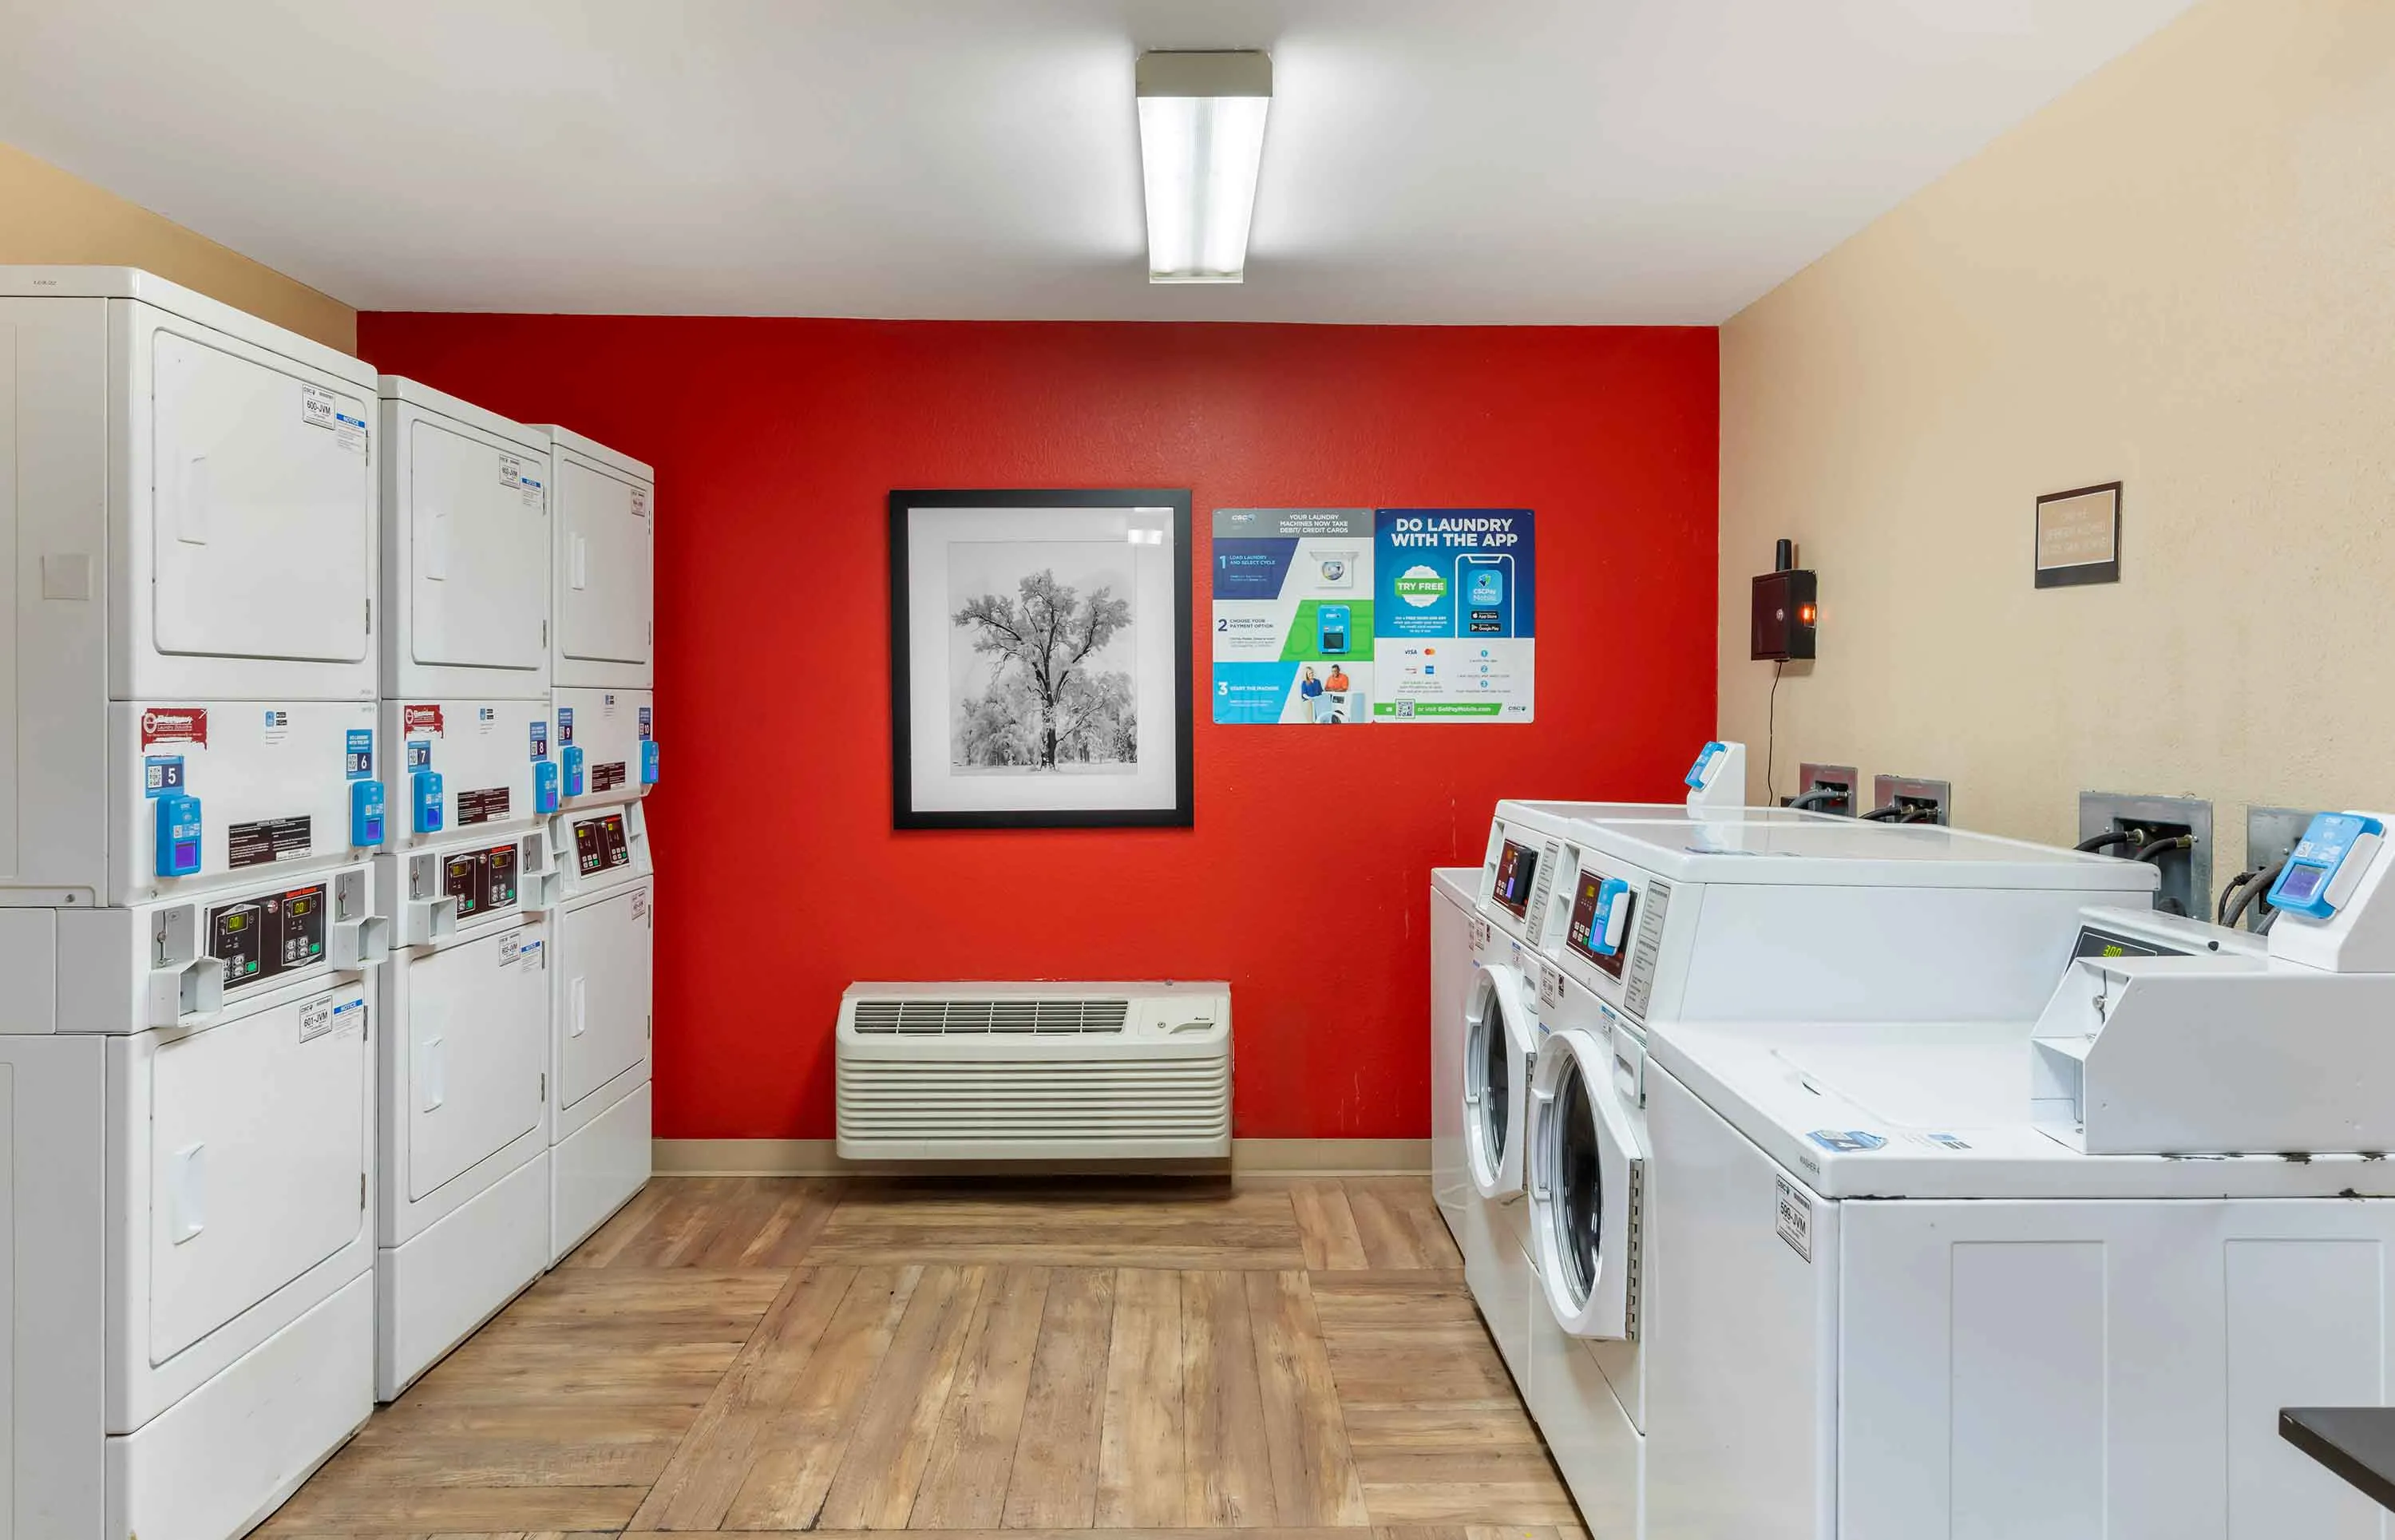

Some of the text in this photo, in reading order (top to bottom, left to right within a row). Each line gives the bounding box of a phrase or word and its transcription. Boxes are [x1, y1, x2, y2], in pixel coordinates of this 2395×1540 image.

[1396, 518, 1513, 532] DO LAUNDRY
[1391, 533, 1518, 546] WITH THE APP
[1219, 555, 1226, 569] 1
[1398, 582, 1444, 591] TRY FREE
[1217, 619, 1228, 631] 2
[1217, 681, 1228, 695] 3
[566, 727, 570, 738] 9
[539, 742, 544, 754] 8
[361, 754, 367, 770] 6
[421, 750, 426, 763] 7
[168, 767, 176, 784] 5
[304, 1011, 327, 1027] 601-JVM
